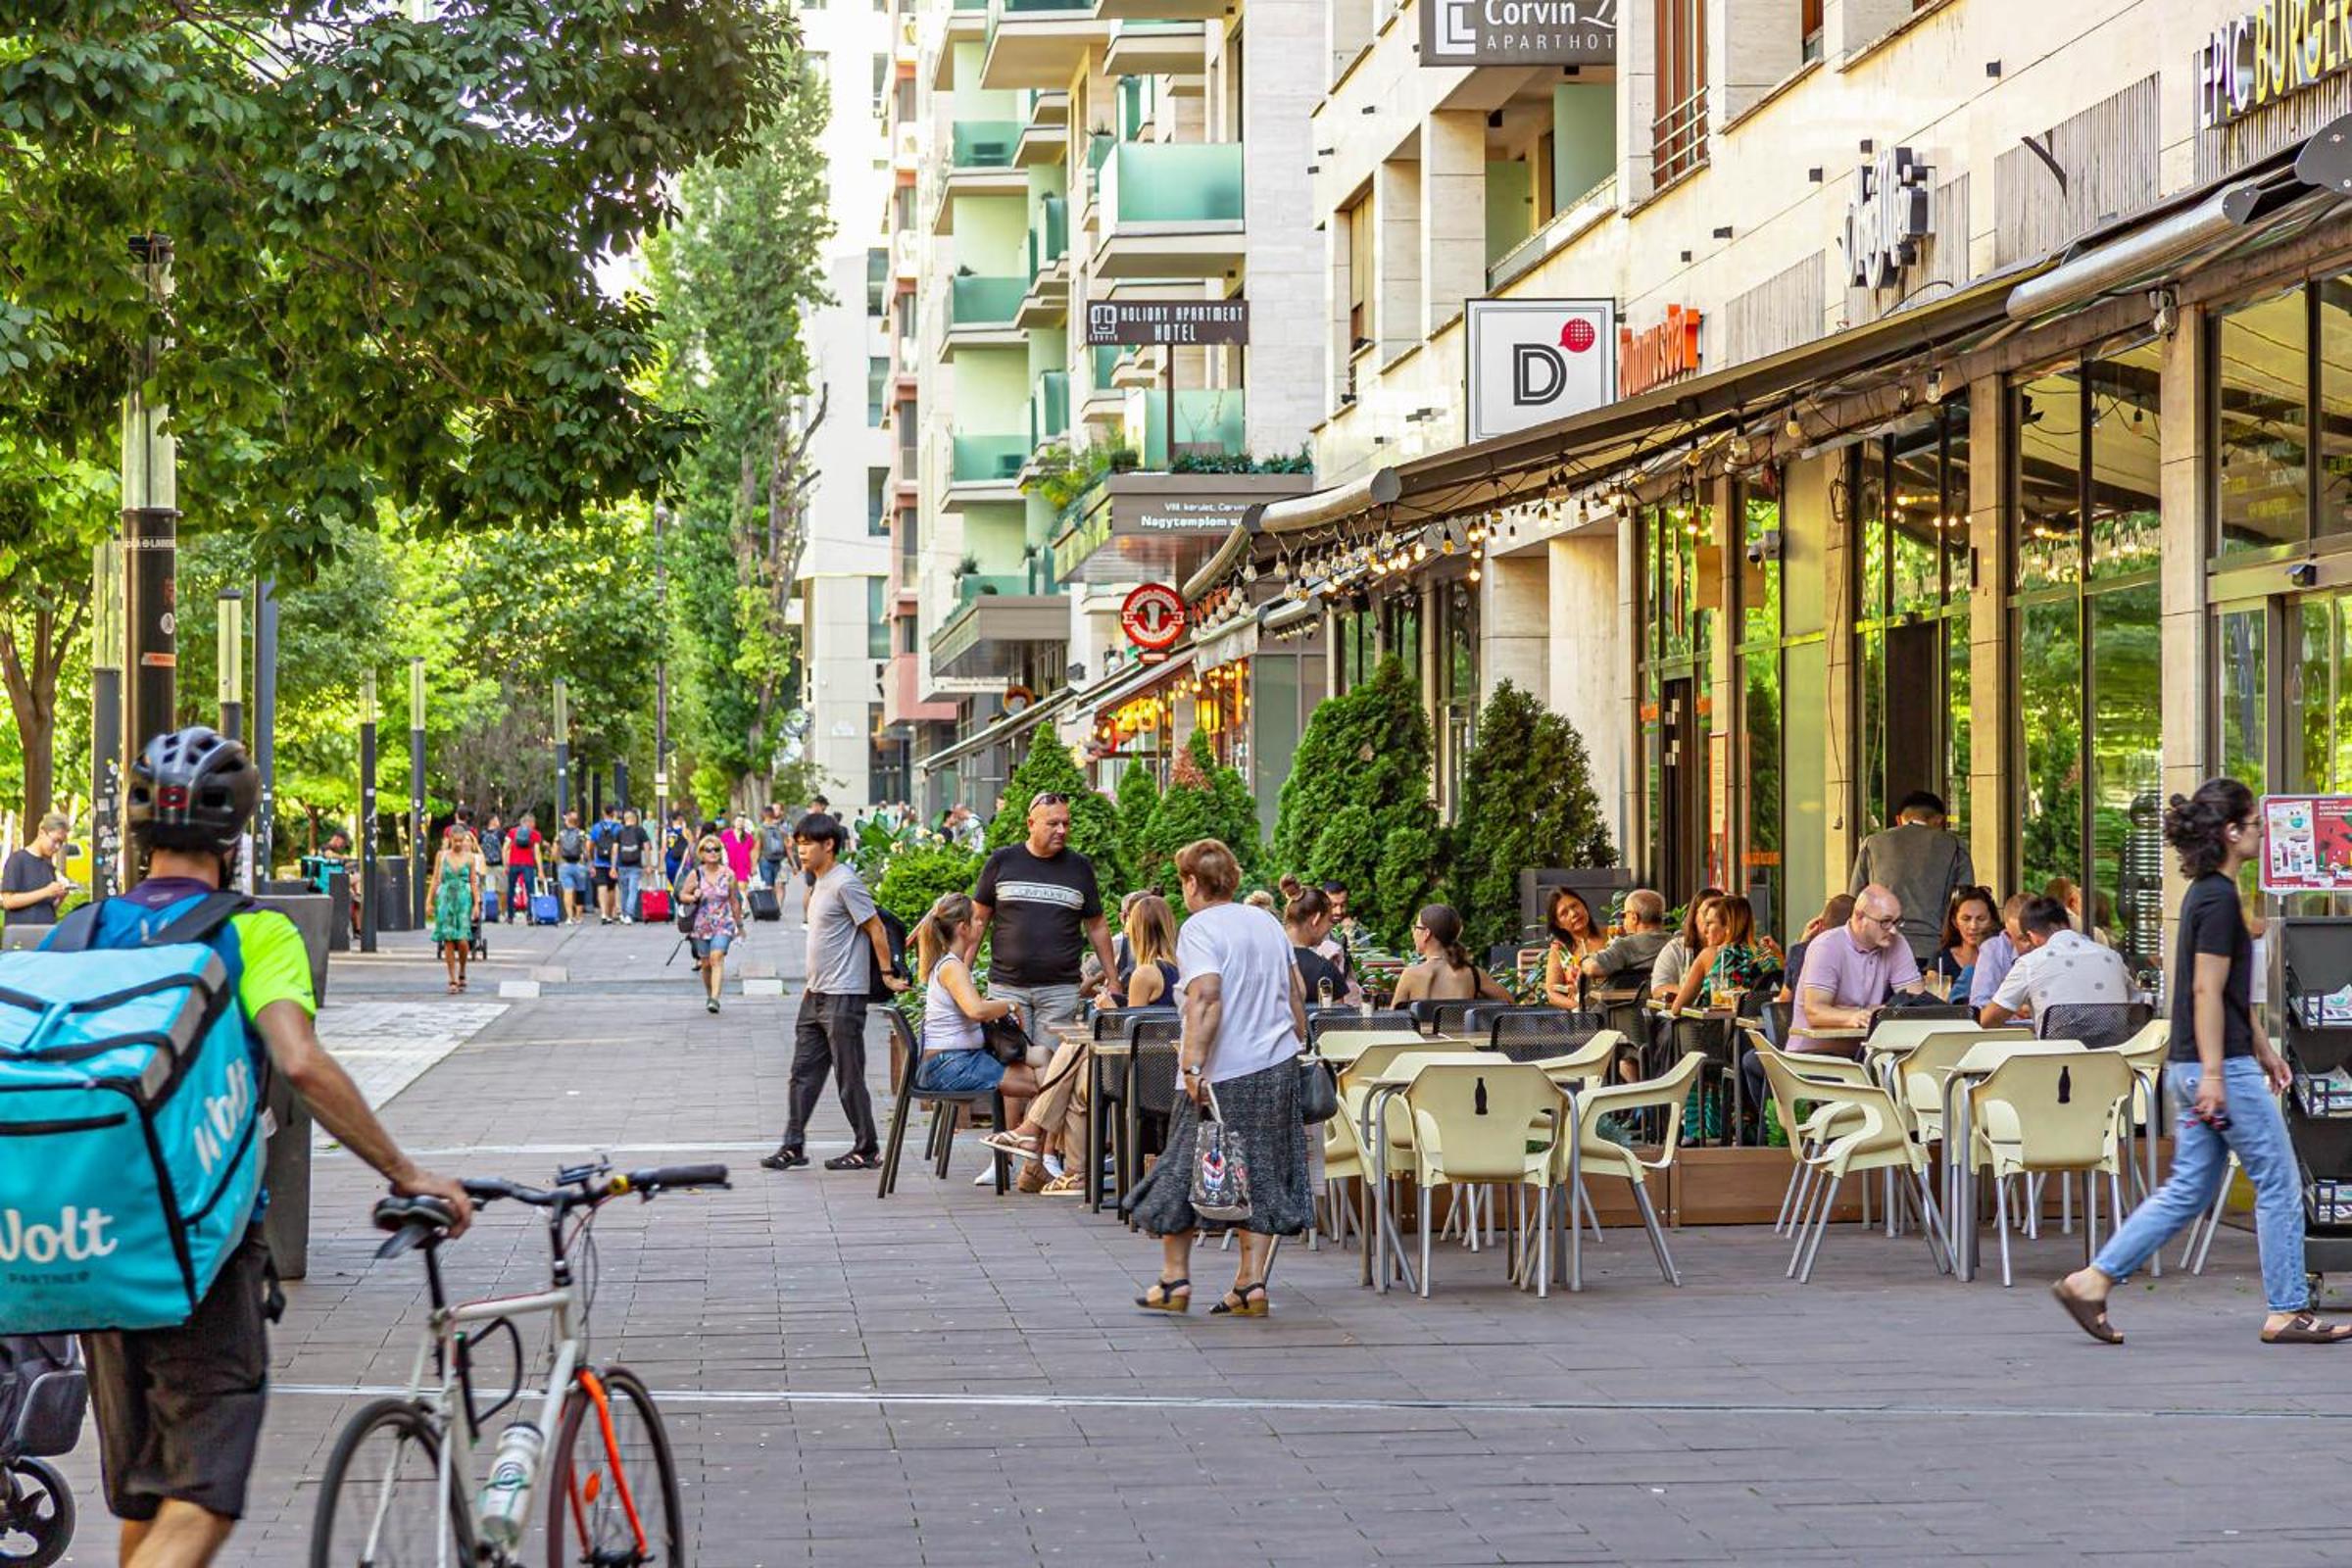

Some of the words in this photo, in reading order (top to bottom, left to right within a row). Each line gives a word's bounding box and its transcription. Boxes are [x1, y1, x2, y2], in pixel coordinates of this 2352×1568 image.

[1484, 0, 1576, 25] Corvin
[1120, 306, 1169, 322] HOLIDAY
[1176, 306, 1244, 322] APARTMENT
[1154, 323, 1197, 342] HOTEL
[1513, 343, 1568, 407] D
